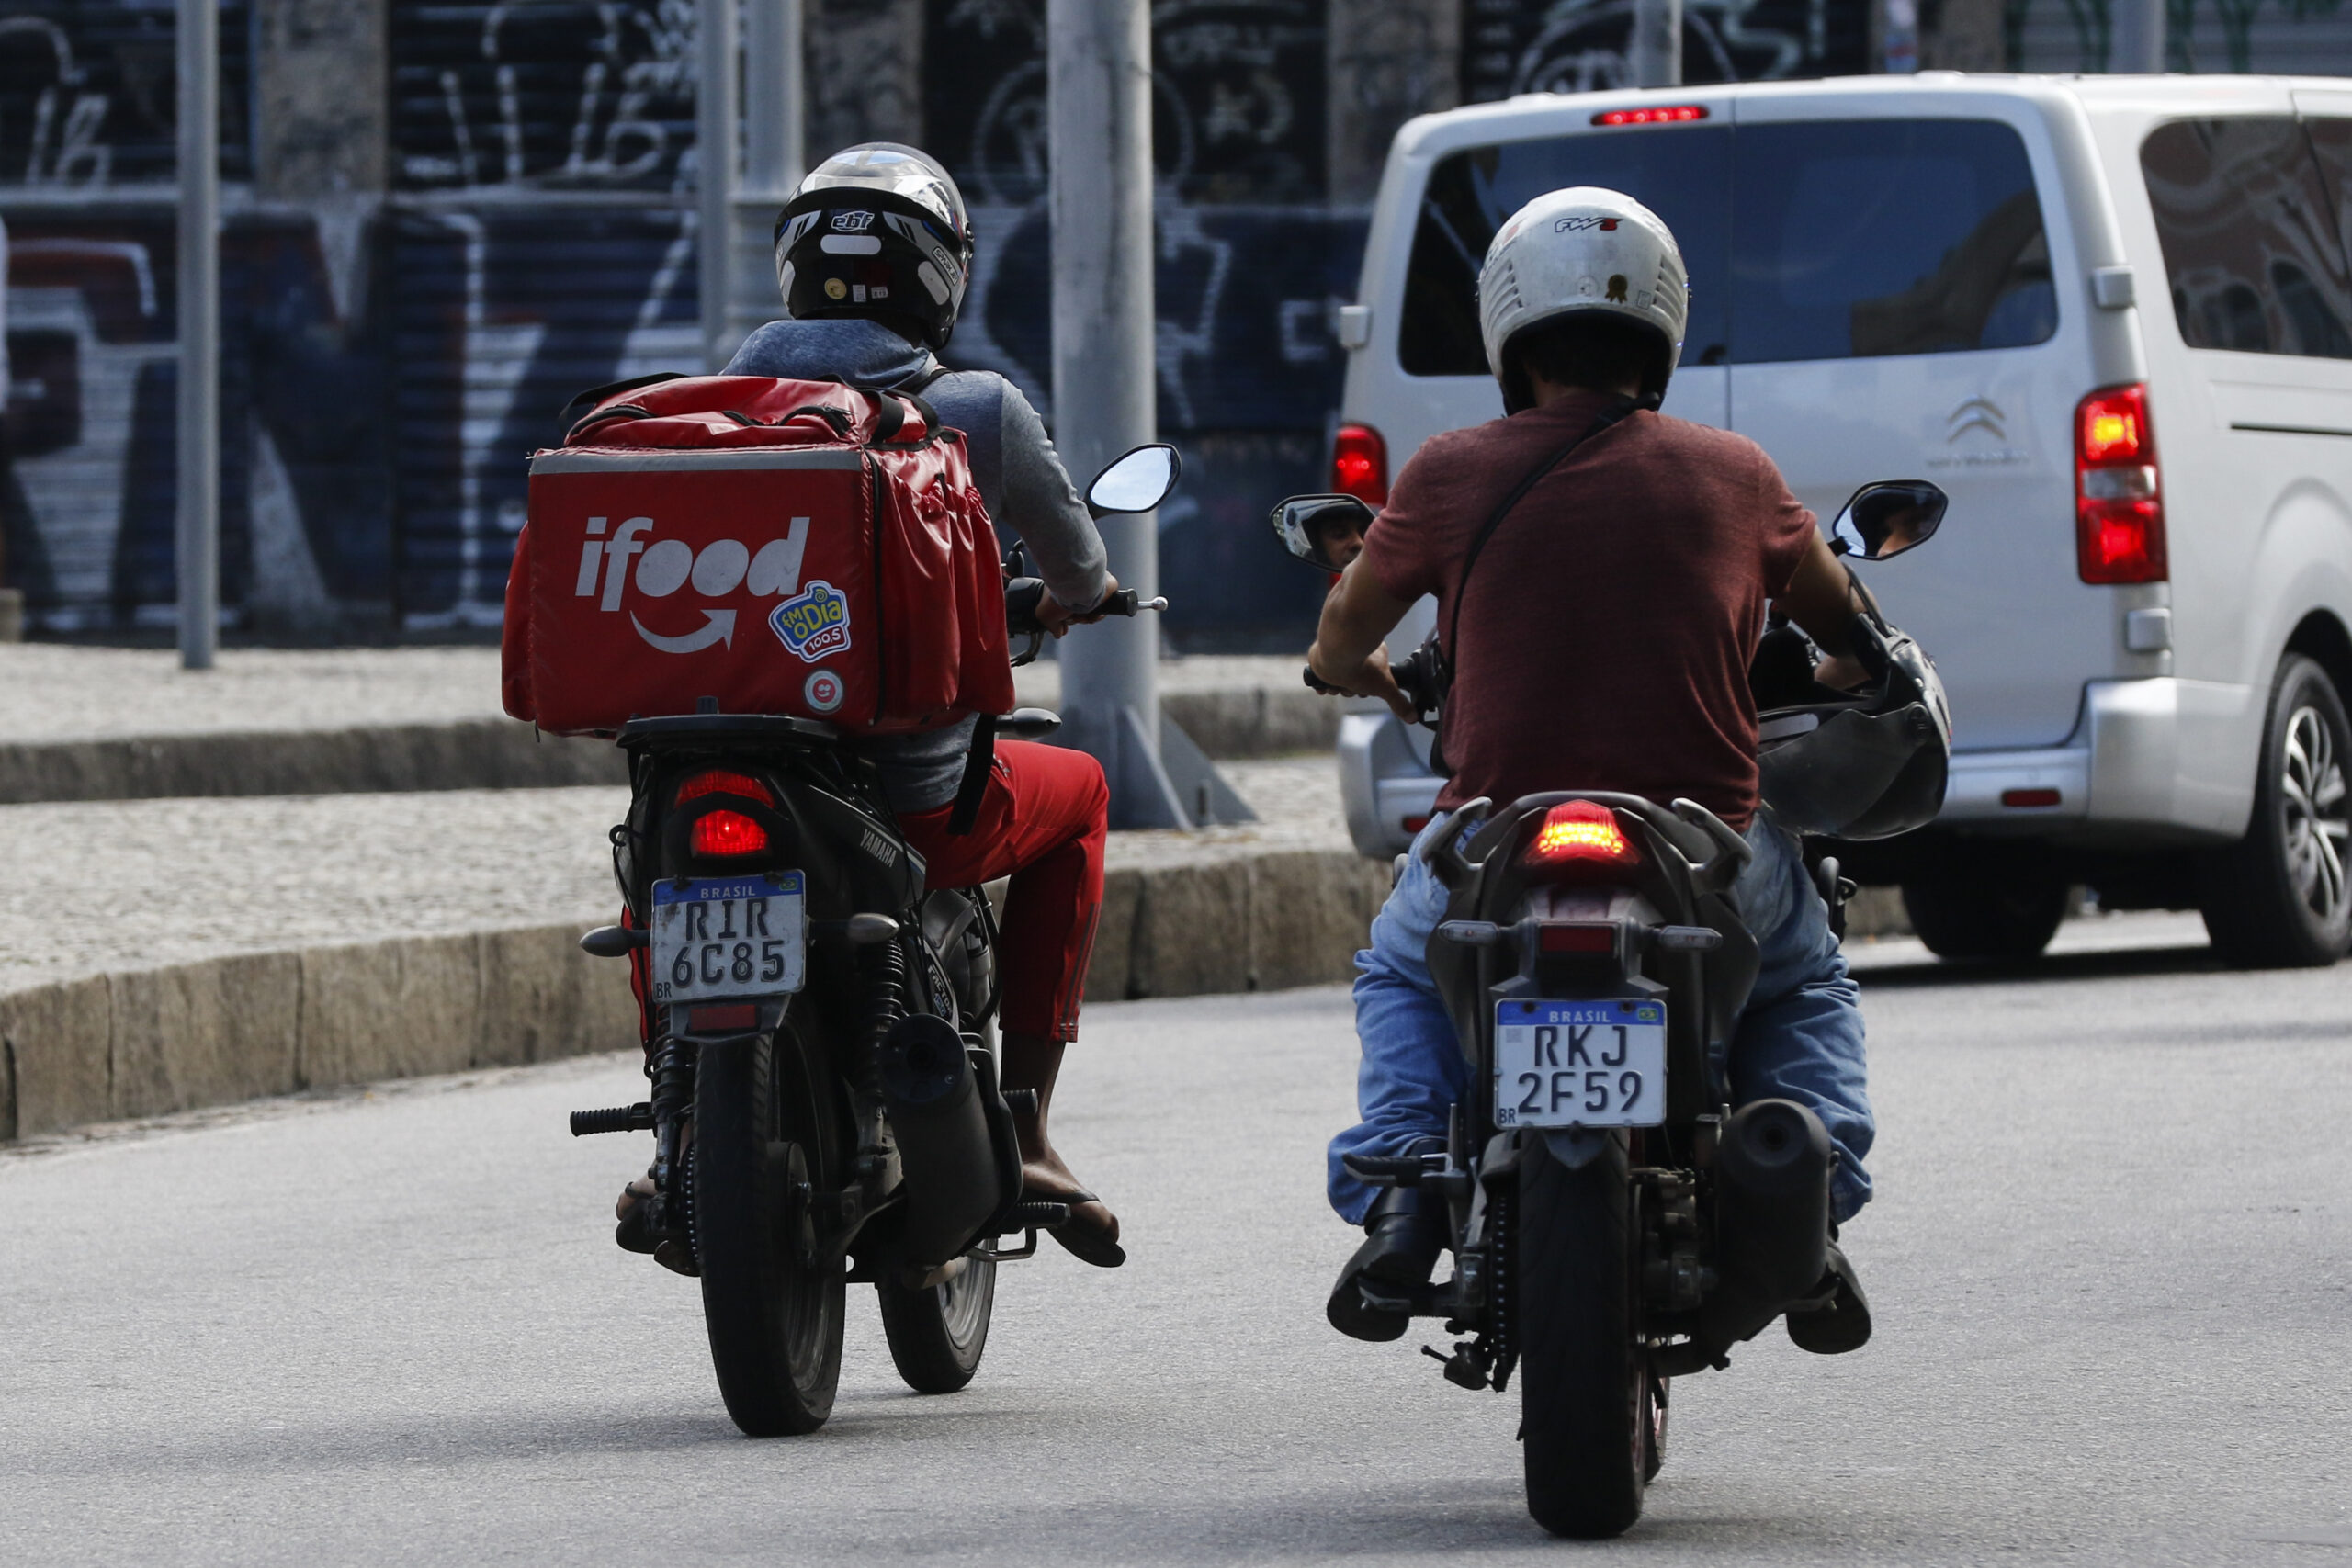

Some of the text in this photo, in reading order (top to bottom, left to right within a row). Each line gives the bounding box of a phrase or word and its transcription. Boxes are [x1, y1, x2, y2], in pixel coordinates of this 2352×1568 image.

[575, 516, 810, 612] ifood
[860, 829, 897, 868] YAMAHA
[700, 886, 756, 899] BRASIL
[685, 897, 769, 942] RIR
[672, 940, 786, 989] 6C85
[655, 982, 673, 999] BR
[1549, 1010, 1611, 1022] BRASIL
[1534, 1025, 1627, 1066] RKJ
[1518, 1070, 1643, 1114] 2F59
[1498, 1108, 1516, 1123] BR
